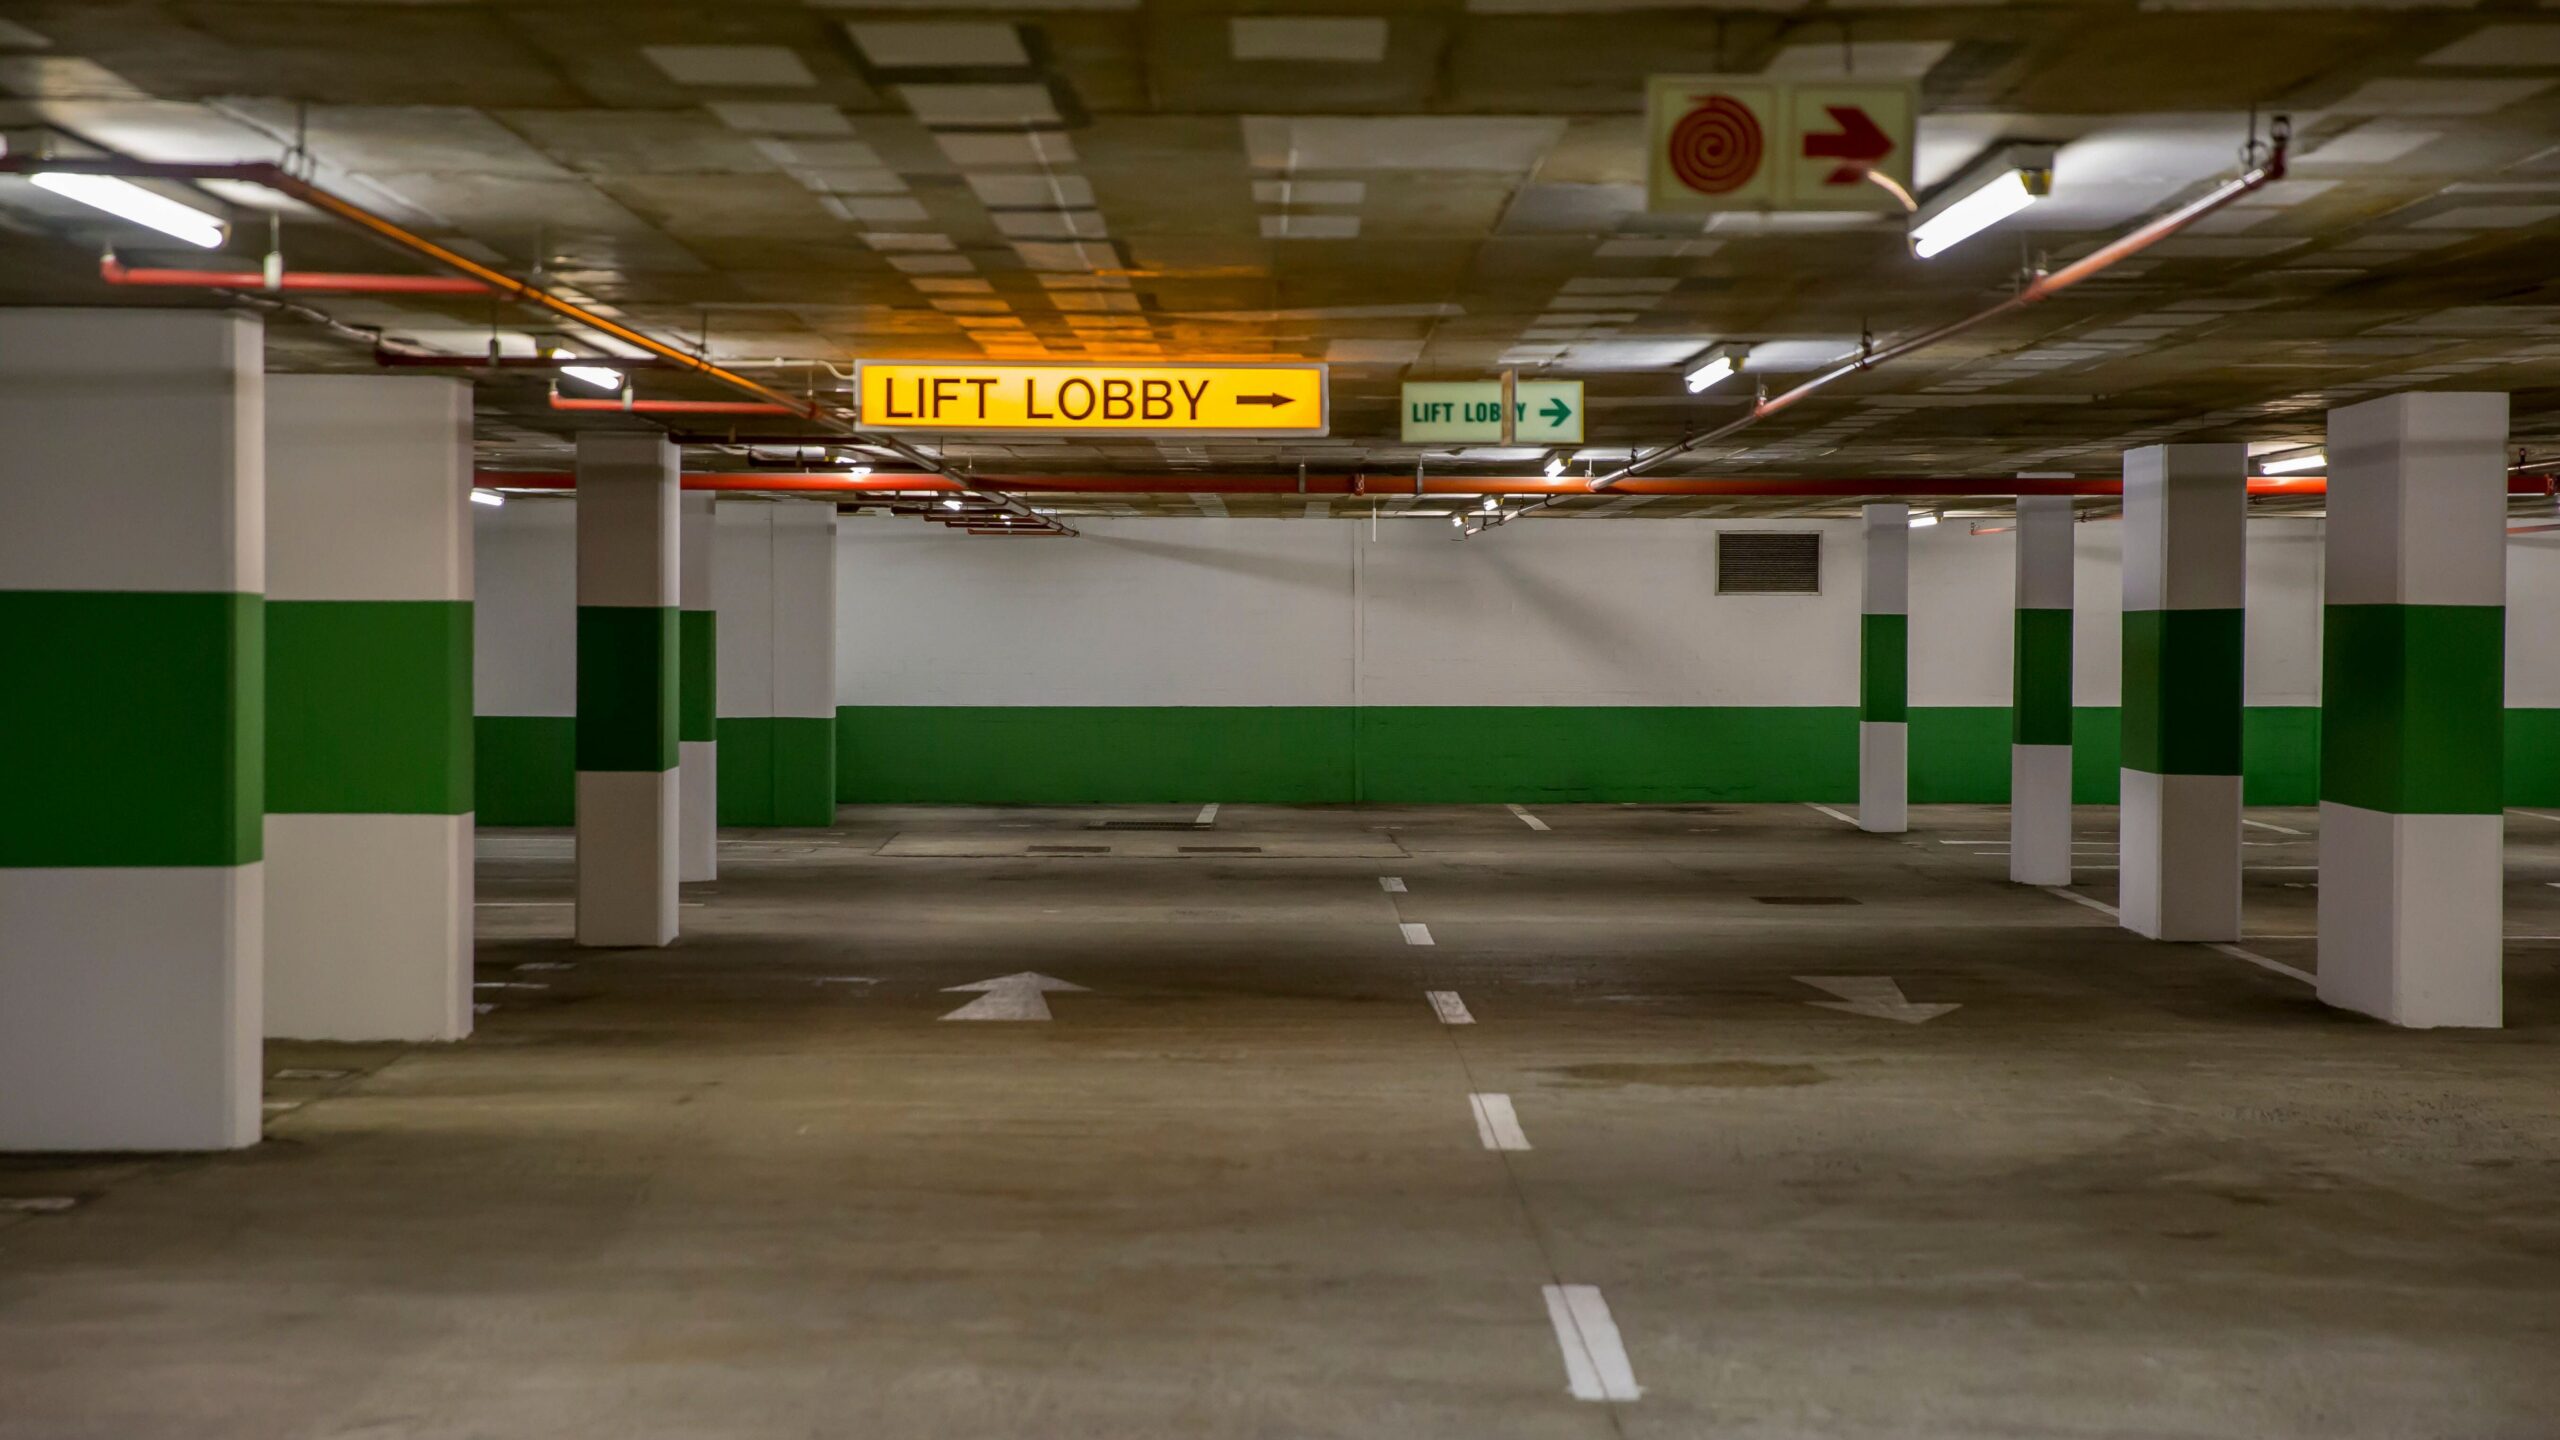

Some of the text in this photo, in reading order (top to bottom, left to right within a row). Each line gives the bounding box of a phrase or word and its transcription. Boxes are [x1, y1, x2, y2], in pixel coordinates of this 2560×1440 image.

[885, 377, 1210, 421] LIFT LOBBY
[1412, 402, 1527, 423] LIFT LOBY
